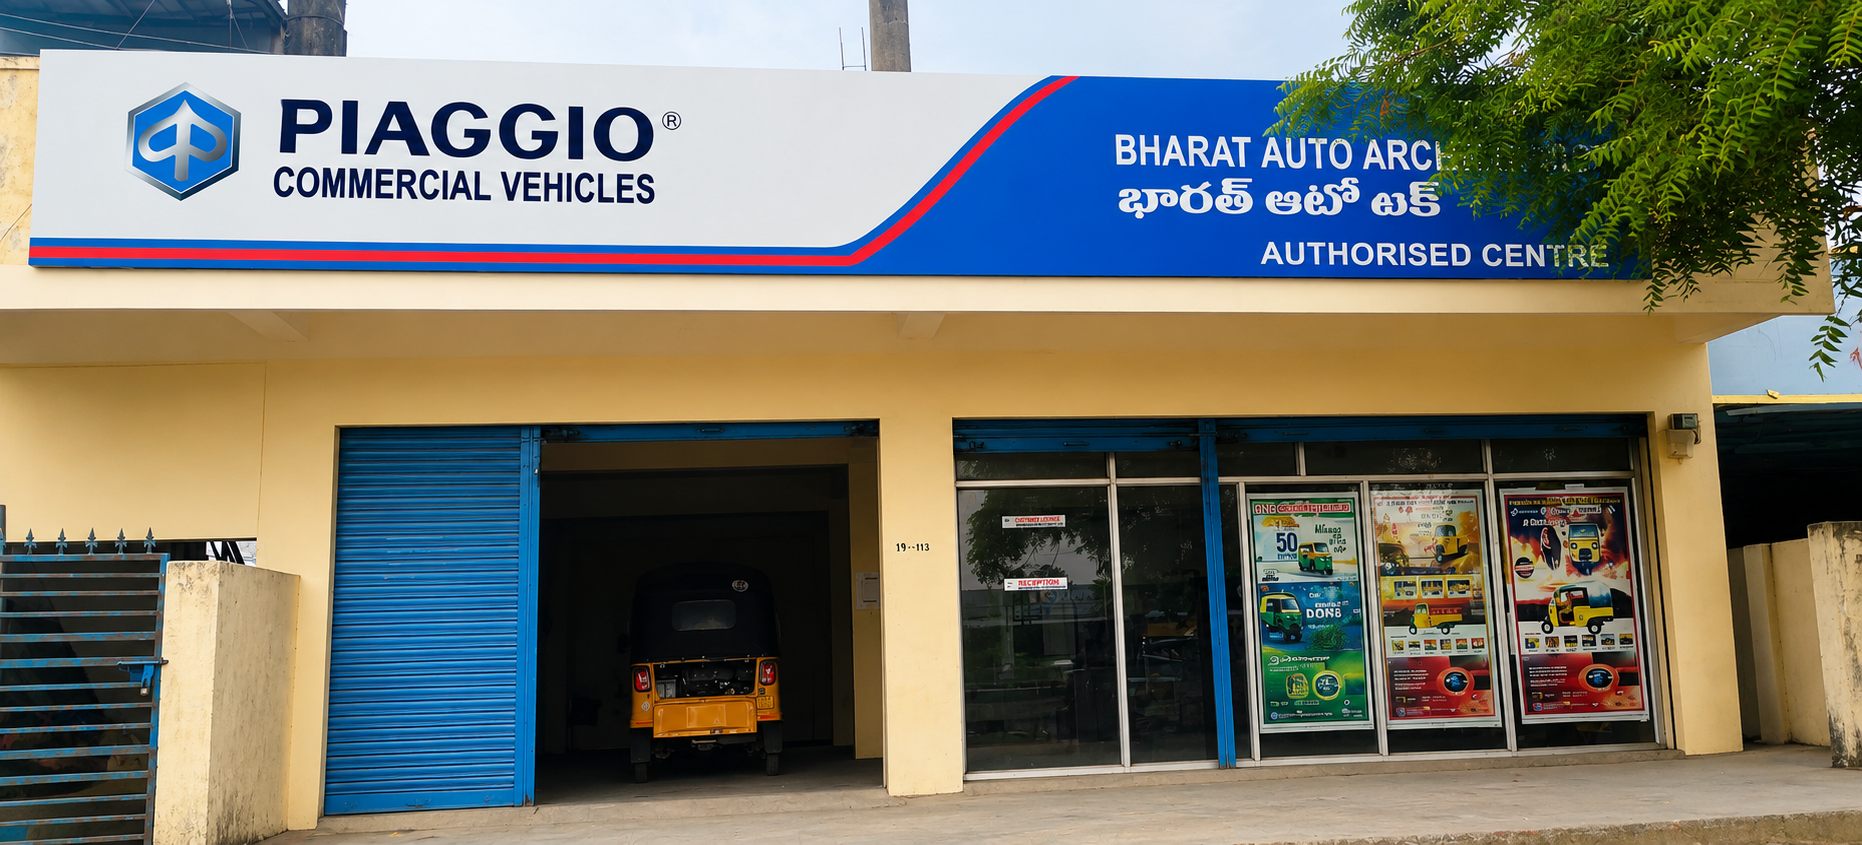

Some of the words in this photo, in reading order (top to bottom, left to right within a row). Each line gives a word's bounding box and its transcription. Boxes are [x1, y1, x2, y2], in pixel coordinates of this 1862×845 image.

[279, 98, 654, 162] PIAGGIO
[1115, 134, 1252, 168] BHARAT
[1261, 136, 1353, 170] AUTO
[273, 165, 492, 201] COMMERCIAL
[500, 171, 656, 204] VEHICLES
[1118, 177, 1254, 219] భారత్
[1265, 177, 1360, 216] ఆటో
[1260, 241, 1472, 267] AUTHORISED
[1482, 243, 1609, 268] CENTRE
[1276, 532, 1298, 553] 50
